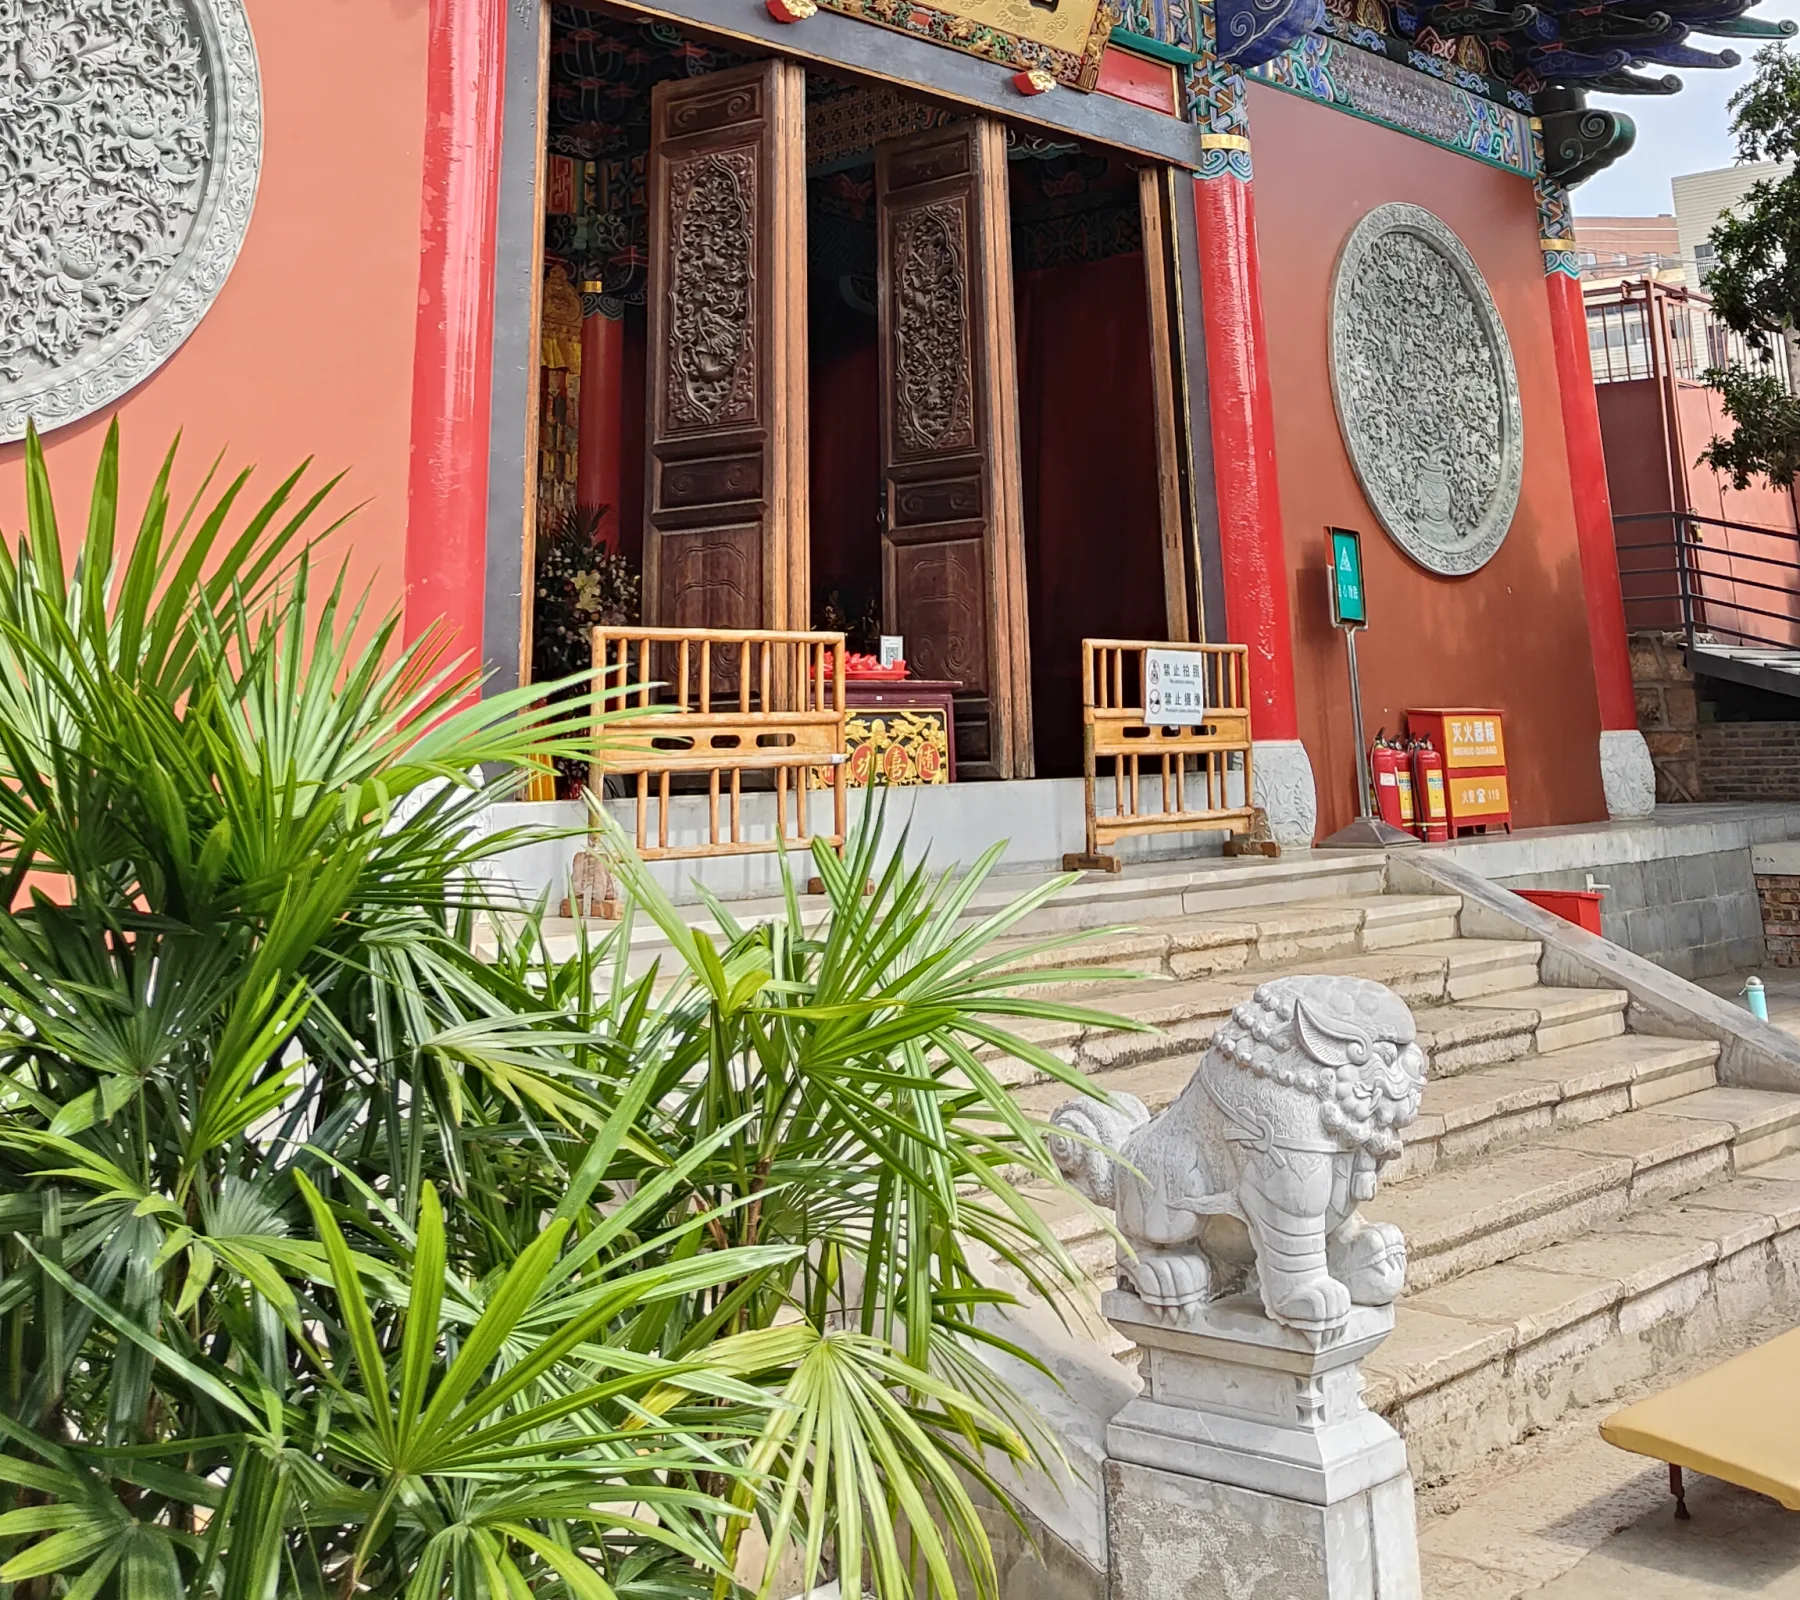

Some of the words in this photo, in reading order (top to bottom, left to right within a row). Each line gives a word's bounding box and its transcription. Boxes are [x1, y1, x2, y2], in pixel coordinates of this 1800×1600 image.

[1163, 663, 1200, 678] 禁止拍照
[1164, 692, 1201, 707] 禁止摄像
[1451, 721, 1496, 743] 灭火器箱
[1488, 789, 1500, 800] 119
